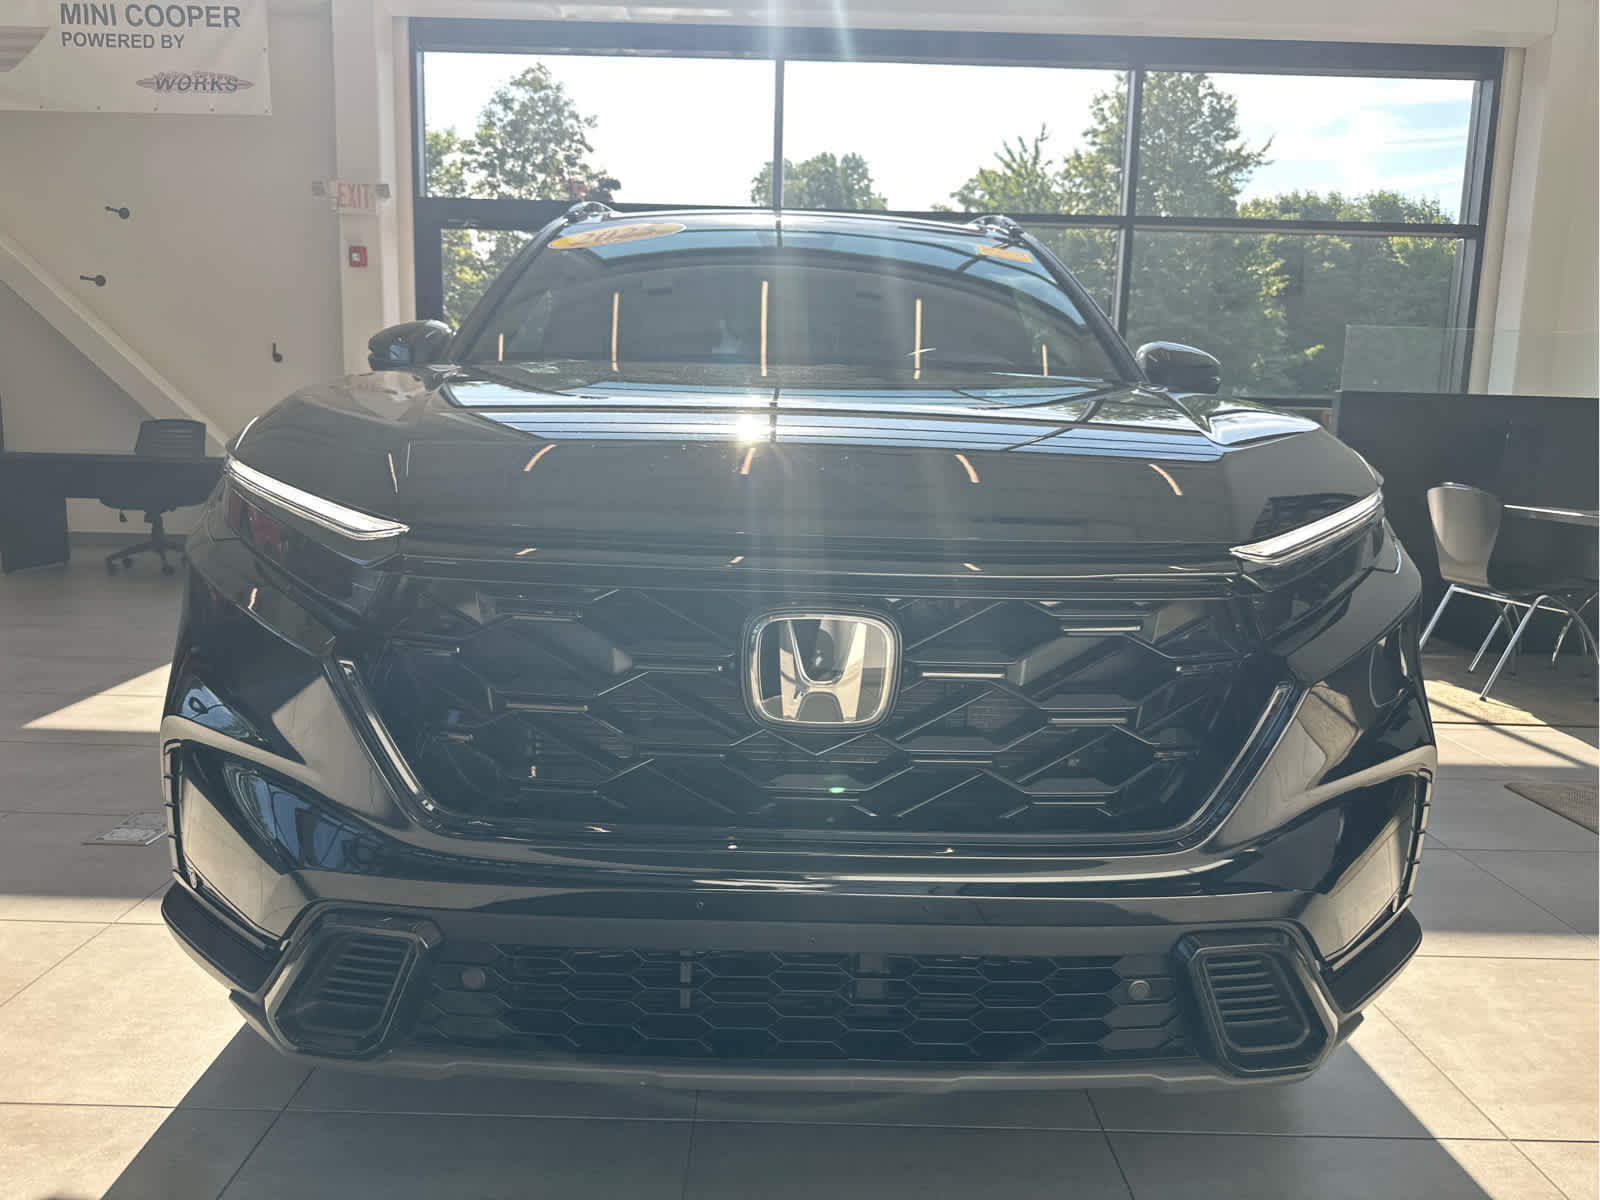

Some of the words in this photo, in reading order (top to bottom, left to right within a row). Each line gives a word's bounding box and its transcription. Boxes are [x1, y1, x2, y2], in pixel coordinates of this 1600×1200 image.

[60, 3, 117, 26] MINI
[125, 4, 241, 28] COOPER
[62, 32, 155, 49] POWERED
[161, 34, 185, 49] BY
[155, 77, 239, 91] WORKS
[337, 183, 369, 208] EXIT
